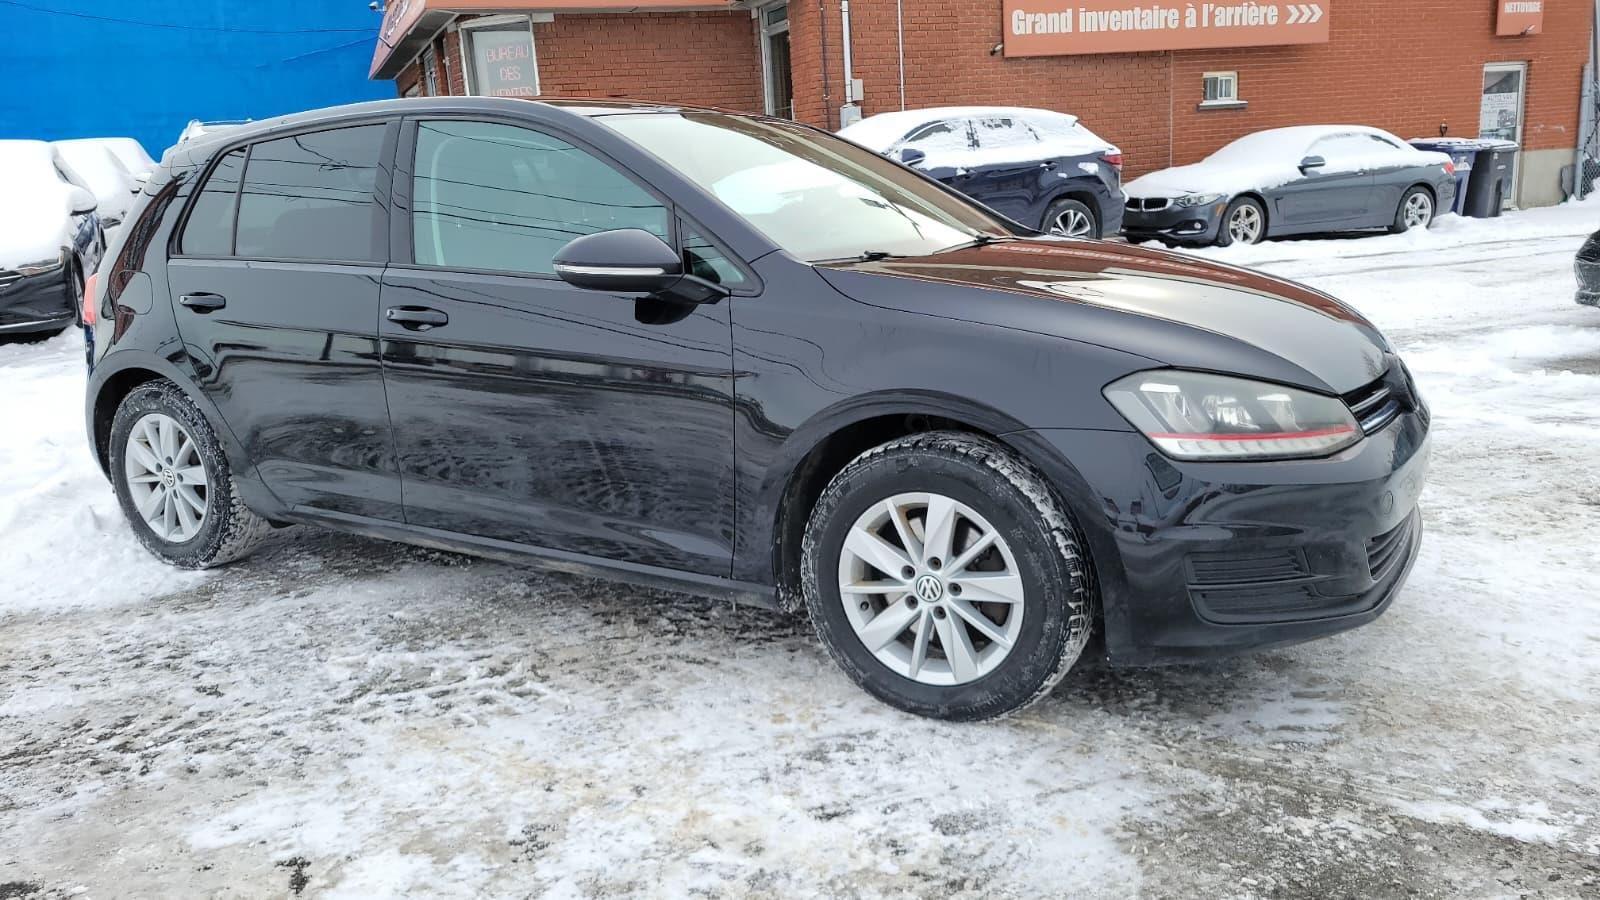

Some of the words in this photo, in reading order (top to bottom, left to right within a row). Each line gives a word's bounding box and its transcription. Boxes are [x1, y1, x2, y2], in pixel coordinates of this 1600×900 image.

[1012, 10, 1072, 35] Grand
[1079, 5, 1179, 33] inventaire
[1185, 3, 1197, 28] à
[487, 44, 529, 62] BUREAU
[500, 65, 520, 80] DES
